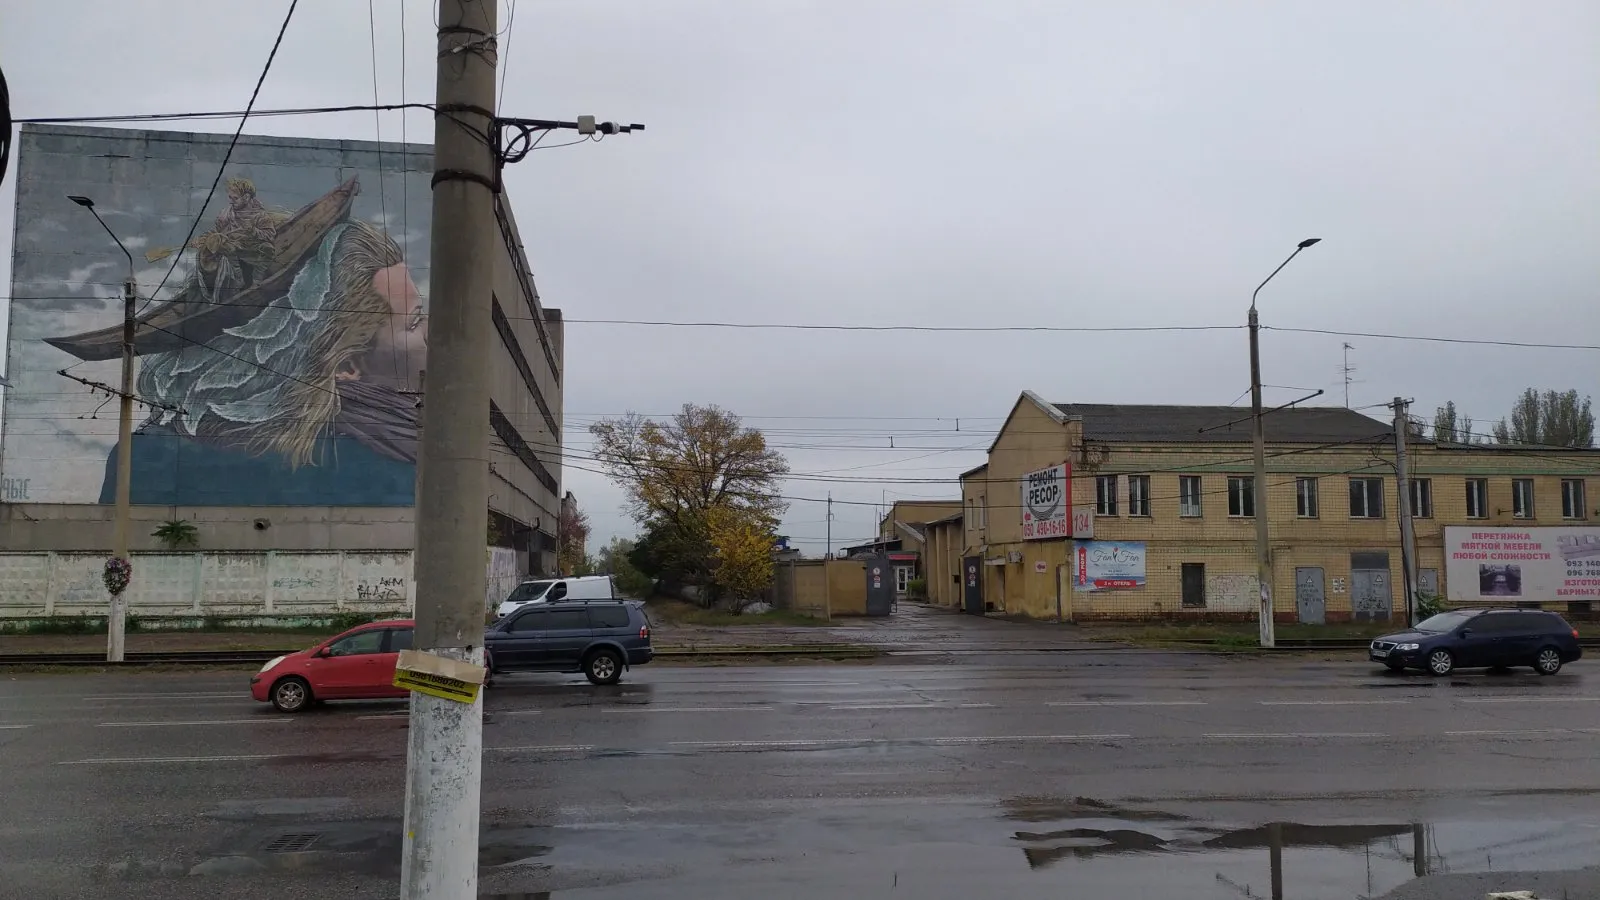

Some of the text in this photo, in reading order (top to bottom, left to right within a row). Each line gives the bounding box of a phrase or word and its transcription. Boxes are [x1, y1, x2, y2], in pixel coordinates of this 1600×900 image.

[1028, 468, 1058, 489] РЕМОНТ
[1029, 485, 1058, 506] РЕСОР
[1074, 512, 1089, 532] 134
[1471, 532, 1531, 540] ПЕРЕТЯЖКА
[1503, 542, 1542, 550] МЕБЕЛИ
[1453, 552, 1551, 560] ЛЮБОЙ СЛОЖНОСТИ
